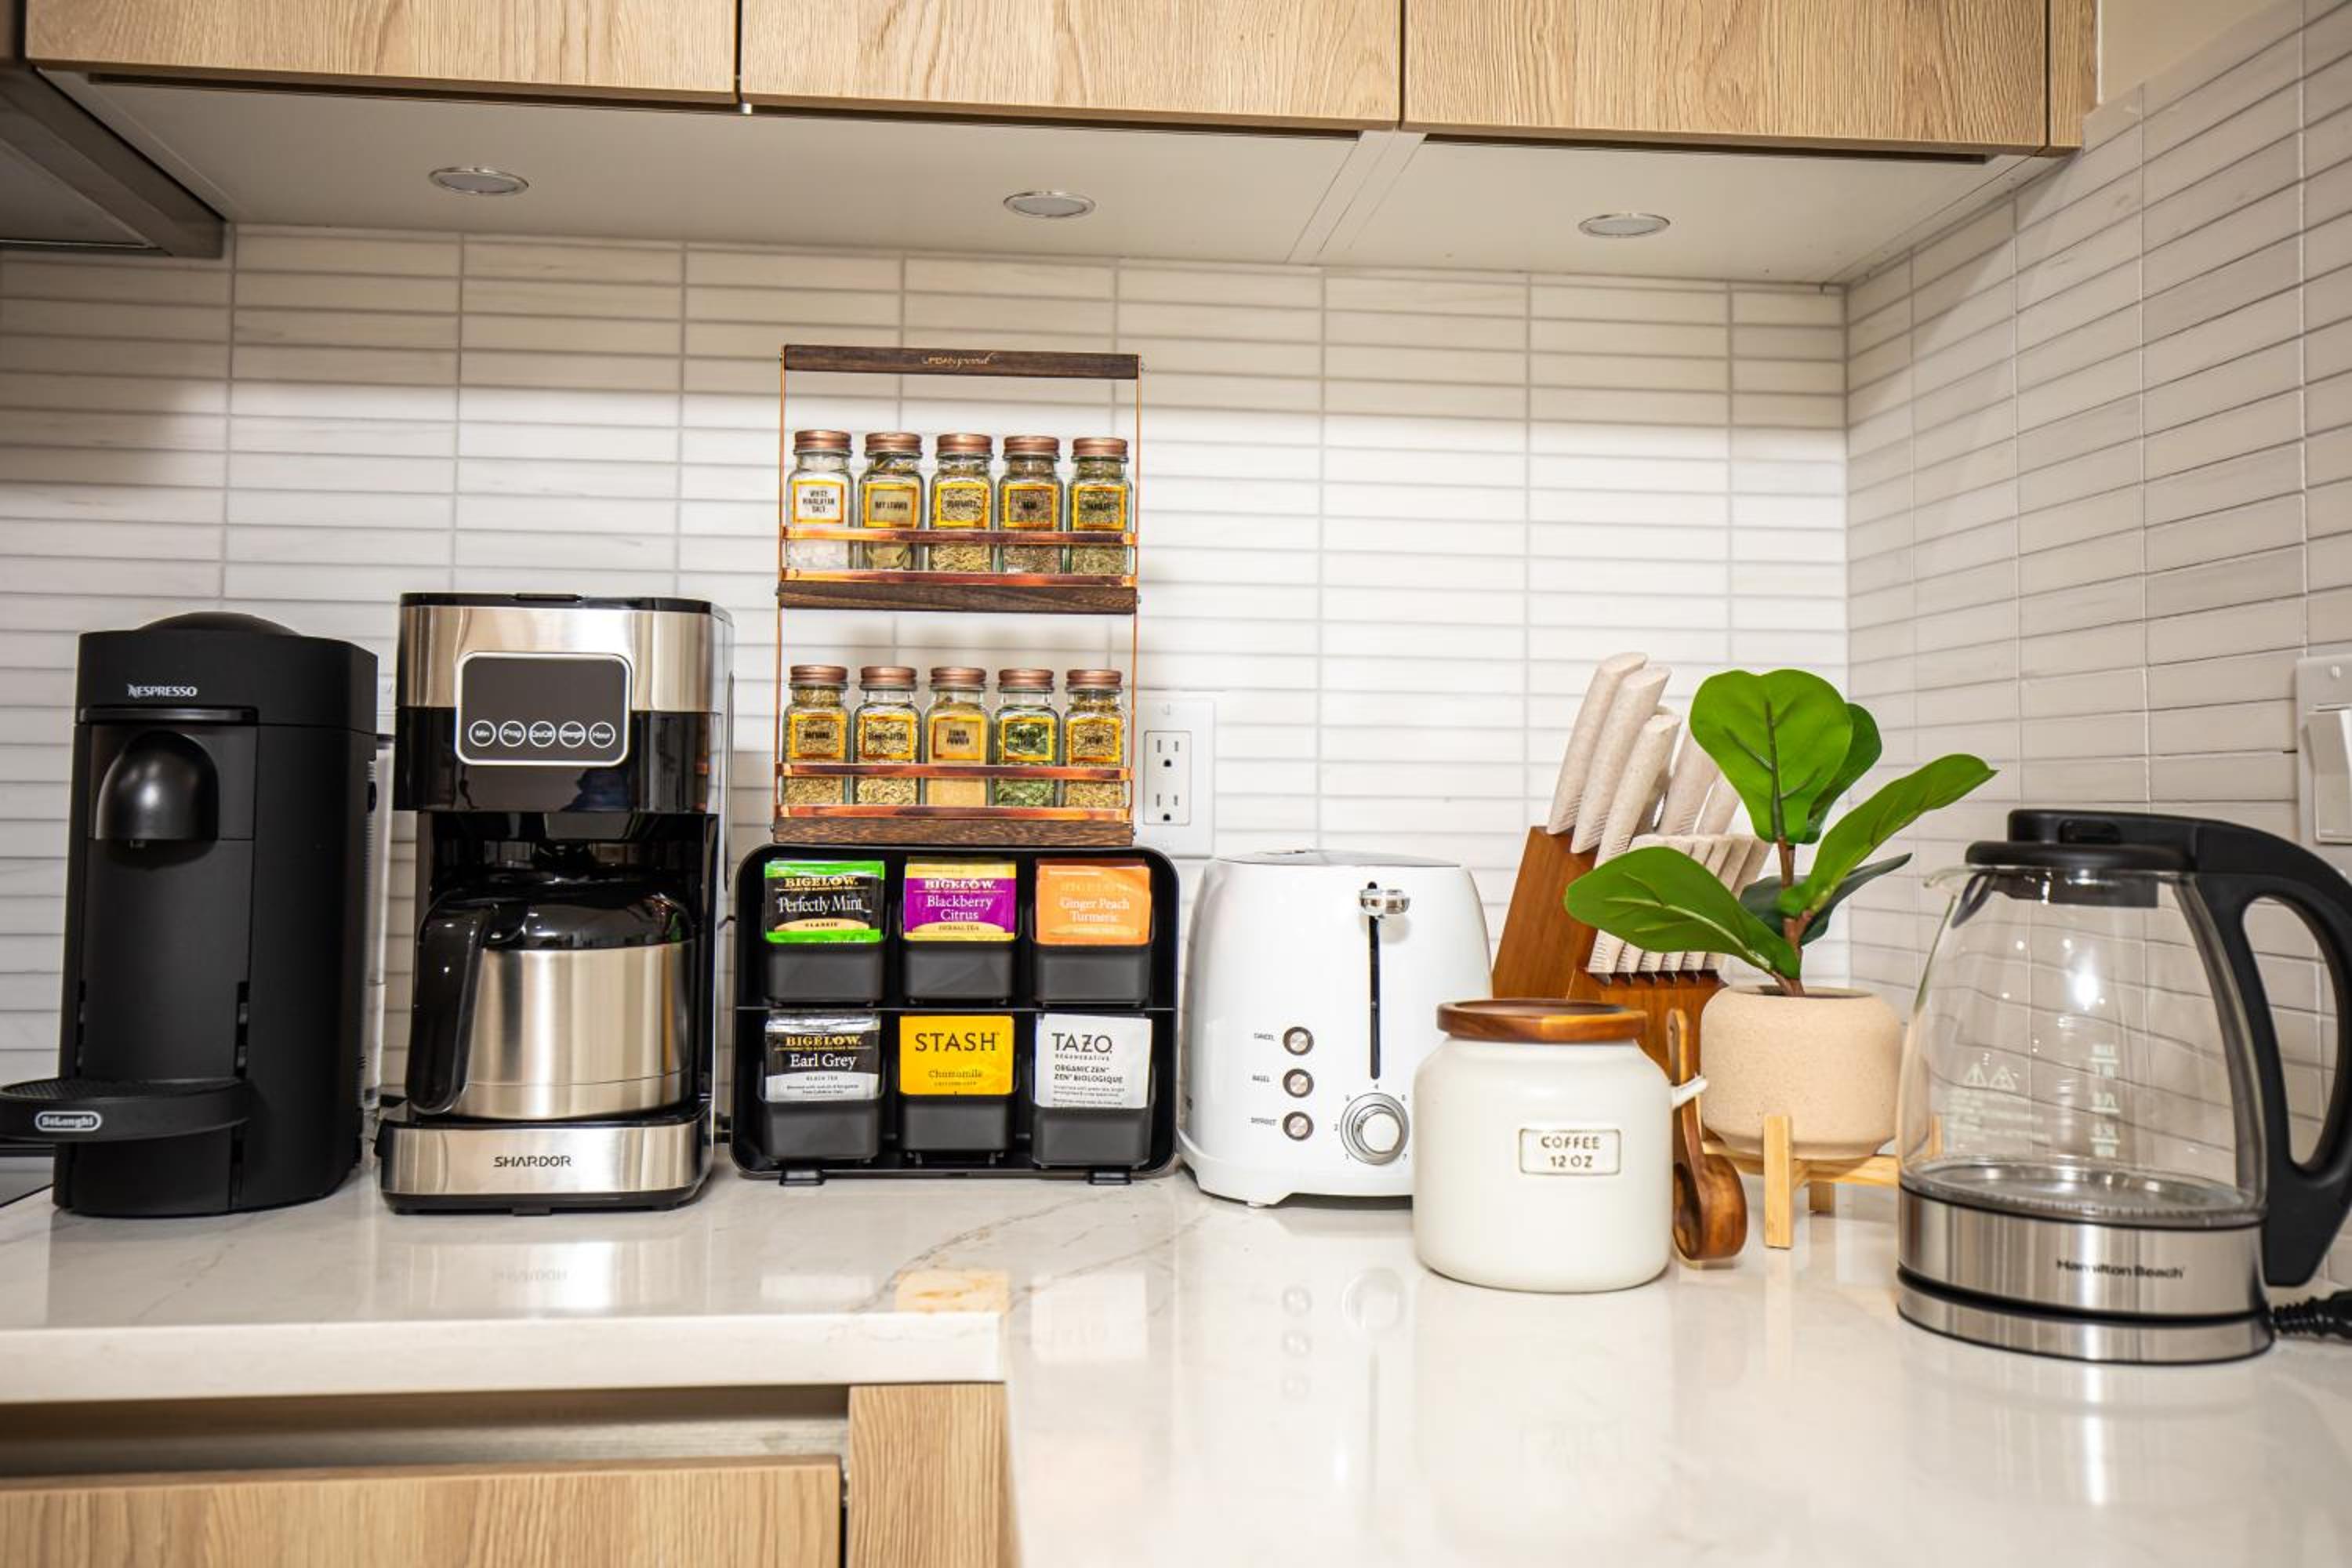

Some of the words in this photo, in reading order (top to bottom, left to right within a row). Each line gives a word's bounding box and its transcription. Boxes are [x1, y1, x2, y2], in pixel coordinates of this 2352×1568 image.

[127, 683, 198, 699] NESPRESSO
[503, 729, 521, 738] Prog
[785, 876, 858, 887] BIGELOW
[925, 878, 996, 890] BIGELOW
[779, 895, 830, 914] Perfectly
[832, 895, 862, 912] Mint
[926, 895, 993, 910] Blackberry
[1059, 898, 1097, 911] Ginger
[1099, 898, 1130, 909] Peach
[941, 909, 978, 920] Citrus
[1070, 911, 1117, 923] Turmeric
[786, 1035, 862, 1047] BIGELOW
[915, 1032, 996, 1051] STASH
[1254, 1033, 1275, 1041] CANCEL
[1051, 1033, 1112, 1054] TAZO
[790, 1054, 818, 1067] Earl
[822, 1054, 857, 1071] Grey
[1054, 1064, 1090, 1073] ORGANIC
[928, 1069, 982, 1078] Chamomile
[1073, 1074, 1123, 1084] BIOLOGIQUE
[1250, 1116, 1276, 1127] DEFROST
[1541, 1136, 1600, 1149] COFFEE
[493, 1155, 572, 1167] SHARDOR
[2135, 1264, 2183, 1279] Beach
